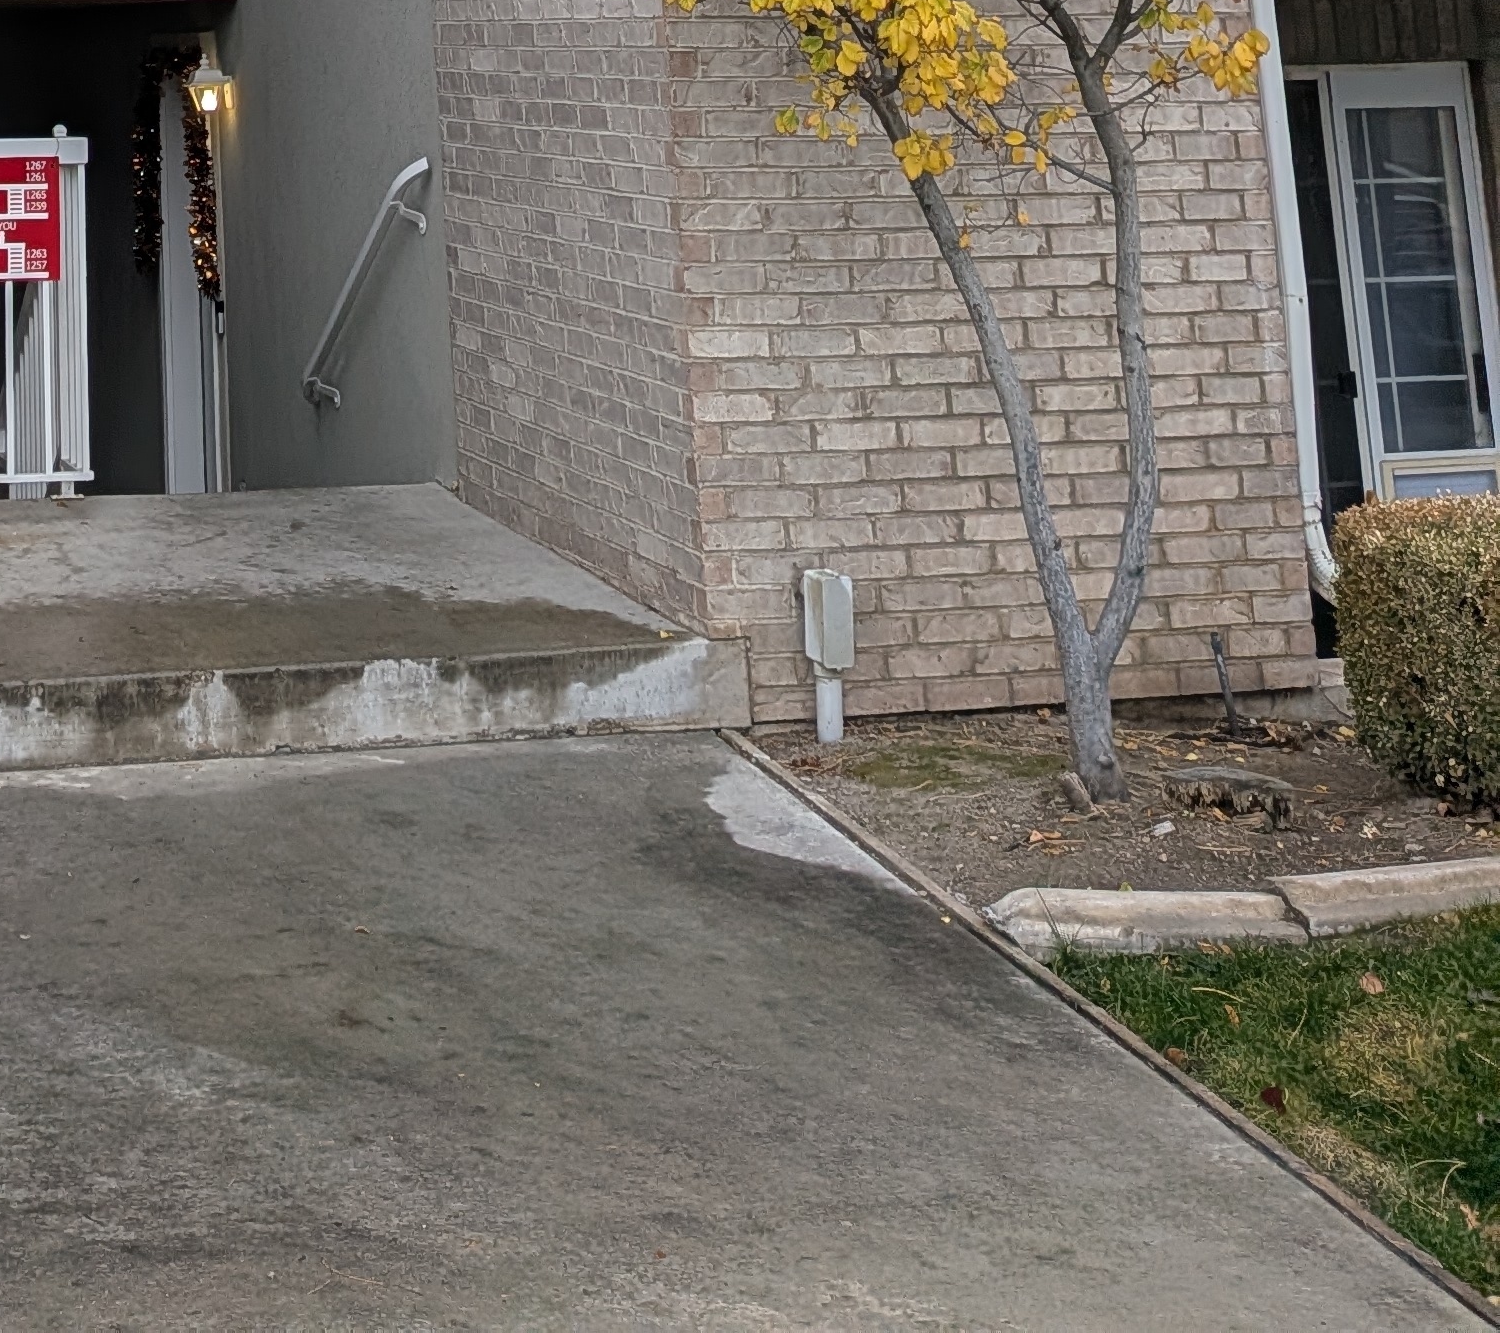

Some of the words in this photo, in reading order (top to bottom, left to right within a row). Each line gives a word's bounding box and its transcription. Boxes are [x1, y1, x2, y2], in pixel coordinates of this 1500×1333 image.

[26, 160, 46, 170] 1267
[26, 172, 46, 182] 1261
[26, 190, 46, 200] 1265
[26, 202, 48, 210] 1259
[26, 248, 48, 258] 1263
[26, 260, 48, 270] 1257
